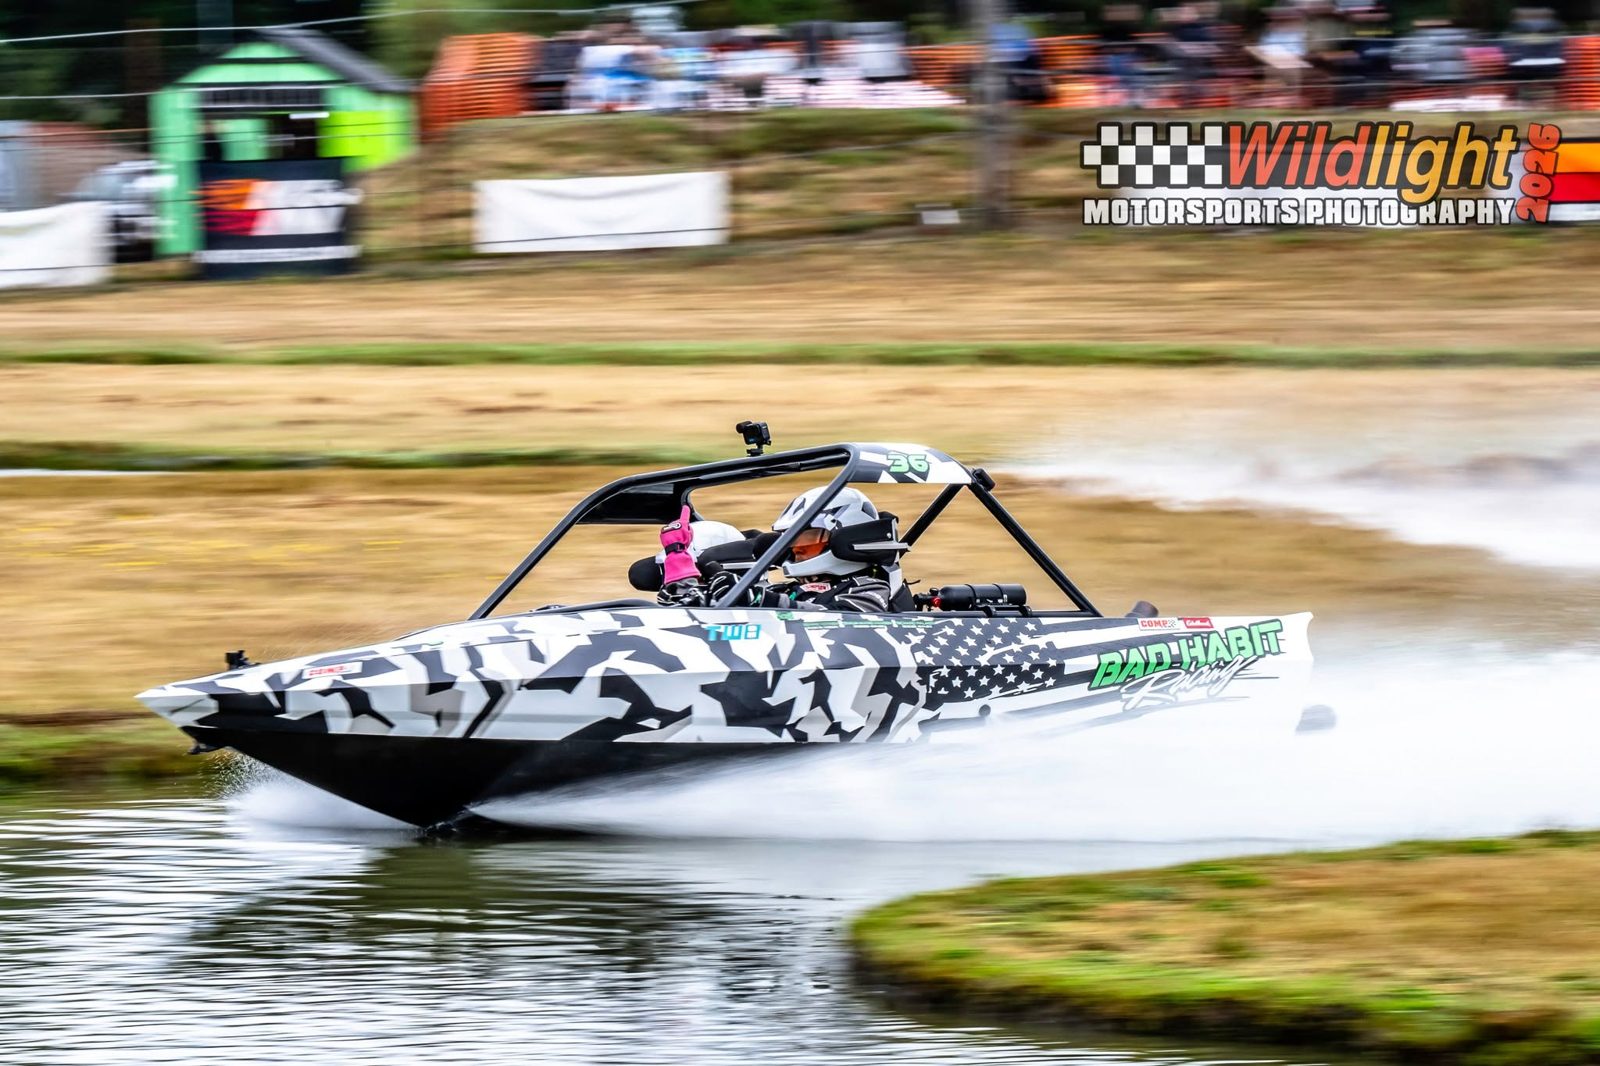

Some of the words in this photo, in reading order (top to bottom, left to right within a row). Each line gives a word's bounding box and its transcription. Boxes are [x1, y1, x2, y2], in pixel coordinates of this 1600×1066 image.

[886, 453, 930, 474] 36
[1088, 642, 1172, 690] BAD
[1177, 619, 1283, 670] HABIT
[1120, 654, 1259, 712] Racing
